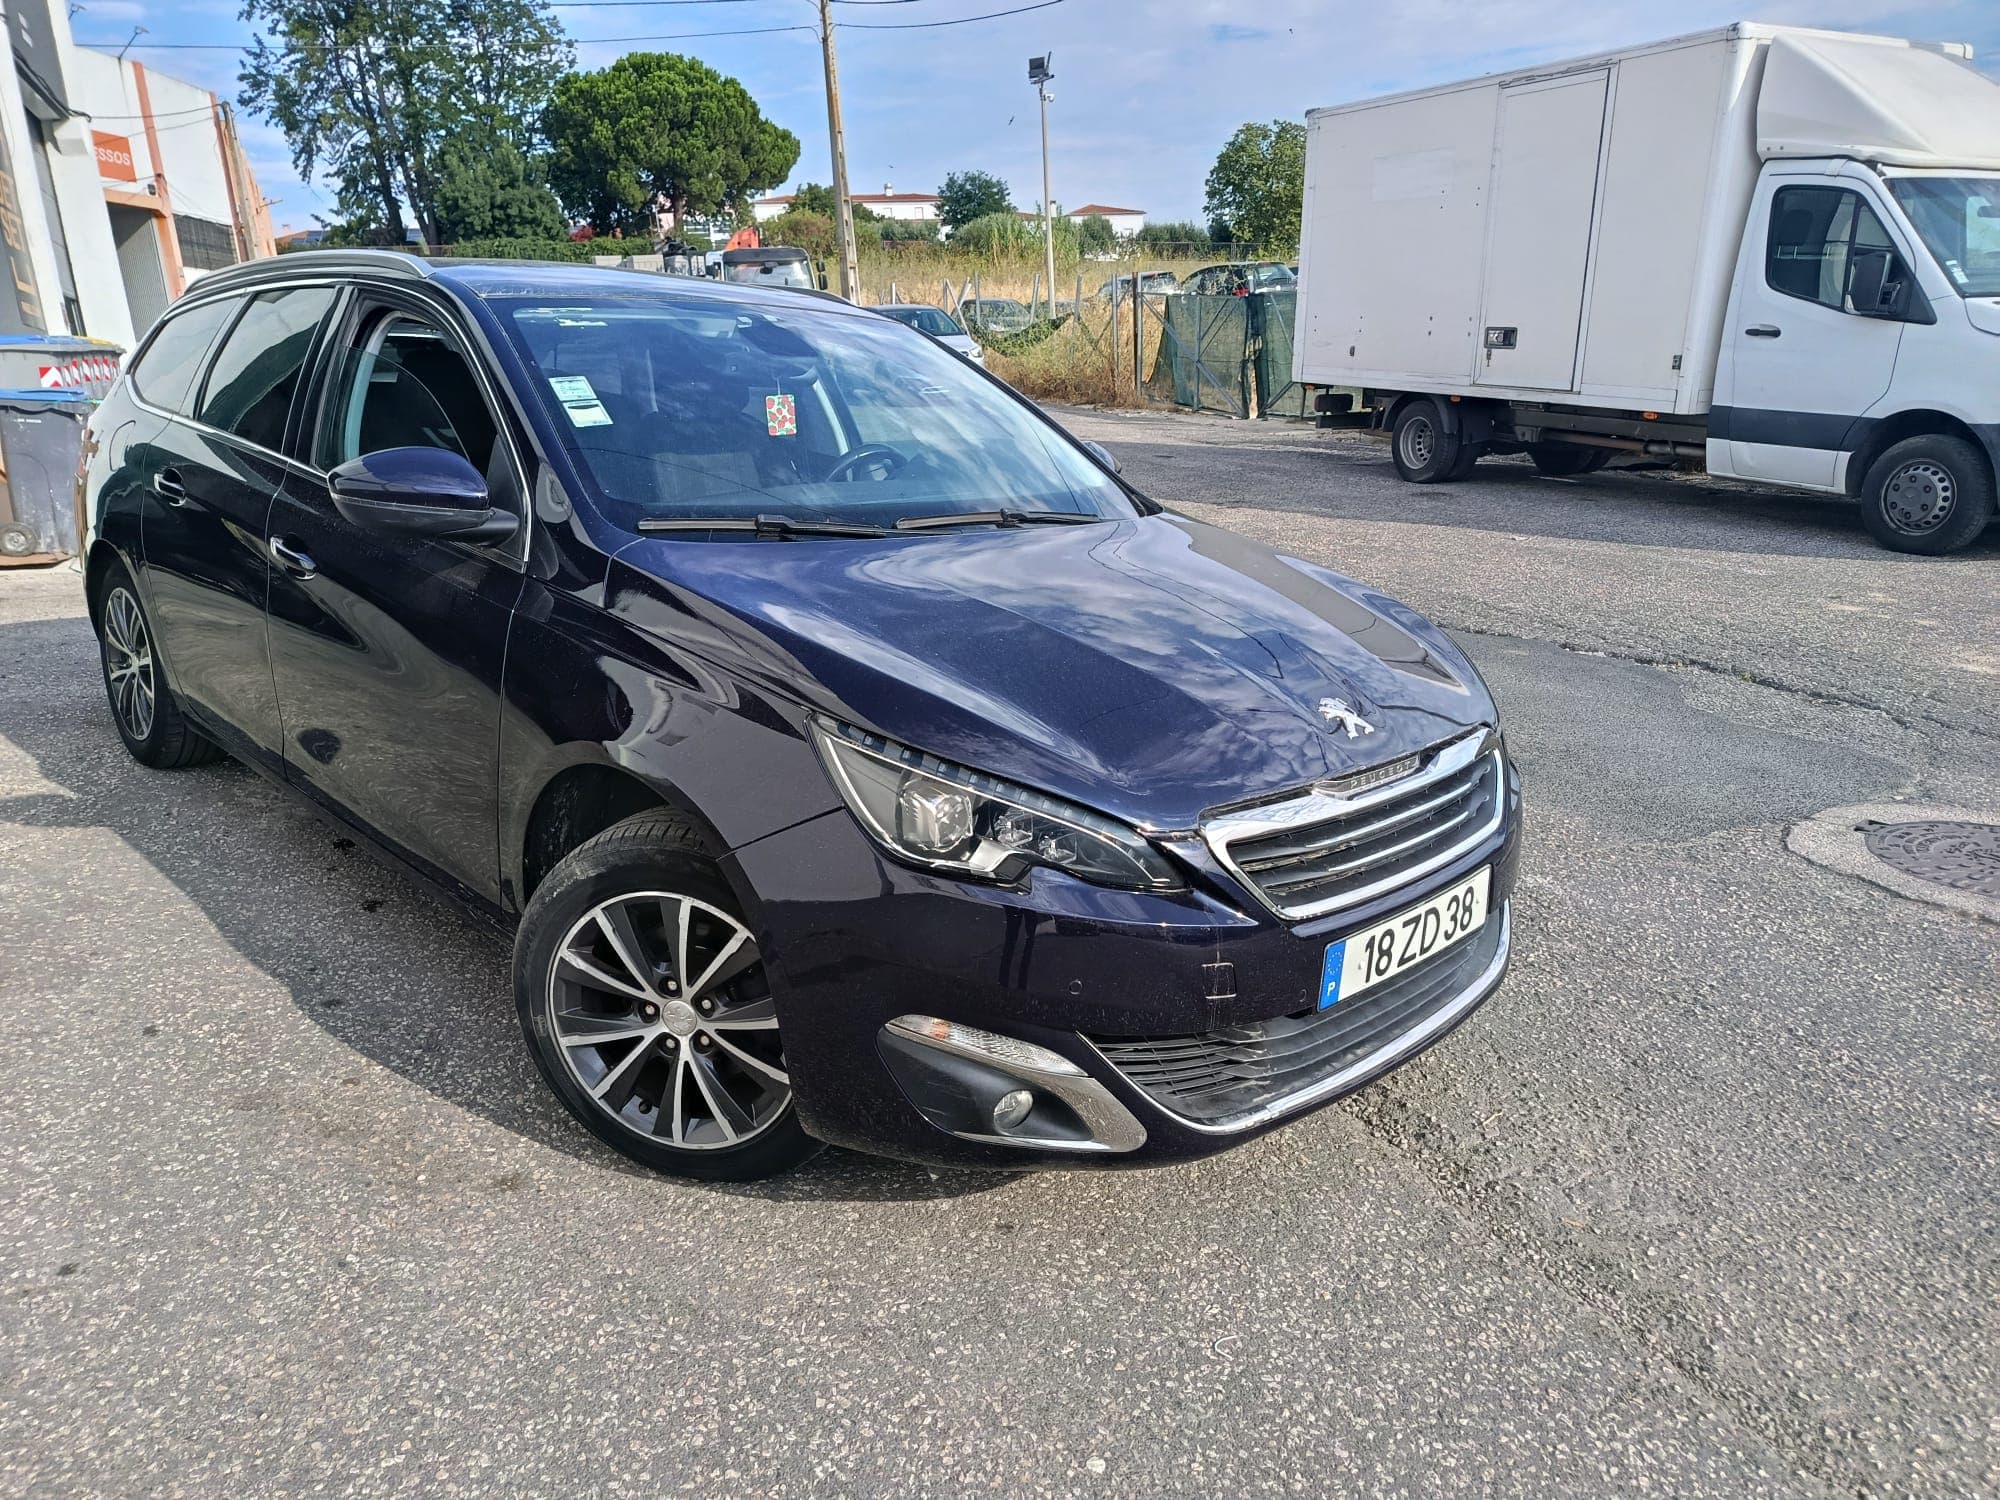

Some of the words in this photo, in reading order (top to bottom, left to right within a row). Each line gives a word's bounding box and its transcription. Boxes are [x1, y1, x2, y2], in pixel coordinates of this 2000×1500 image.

[1350, 760, 1411, 790] PEUGEOT
[1364, 928, 1396, 983] 18
[1397, 906, 1441, 969] ZD
[1443, 885, 1475, 942] 38
[1327, 981, 1336, 997] P
